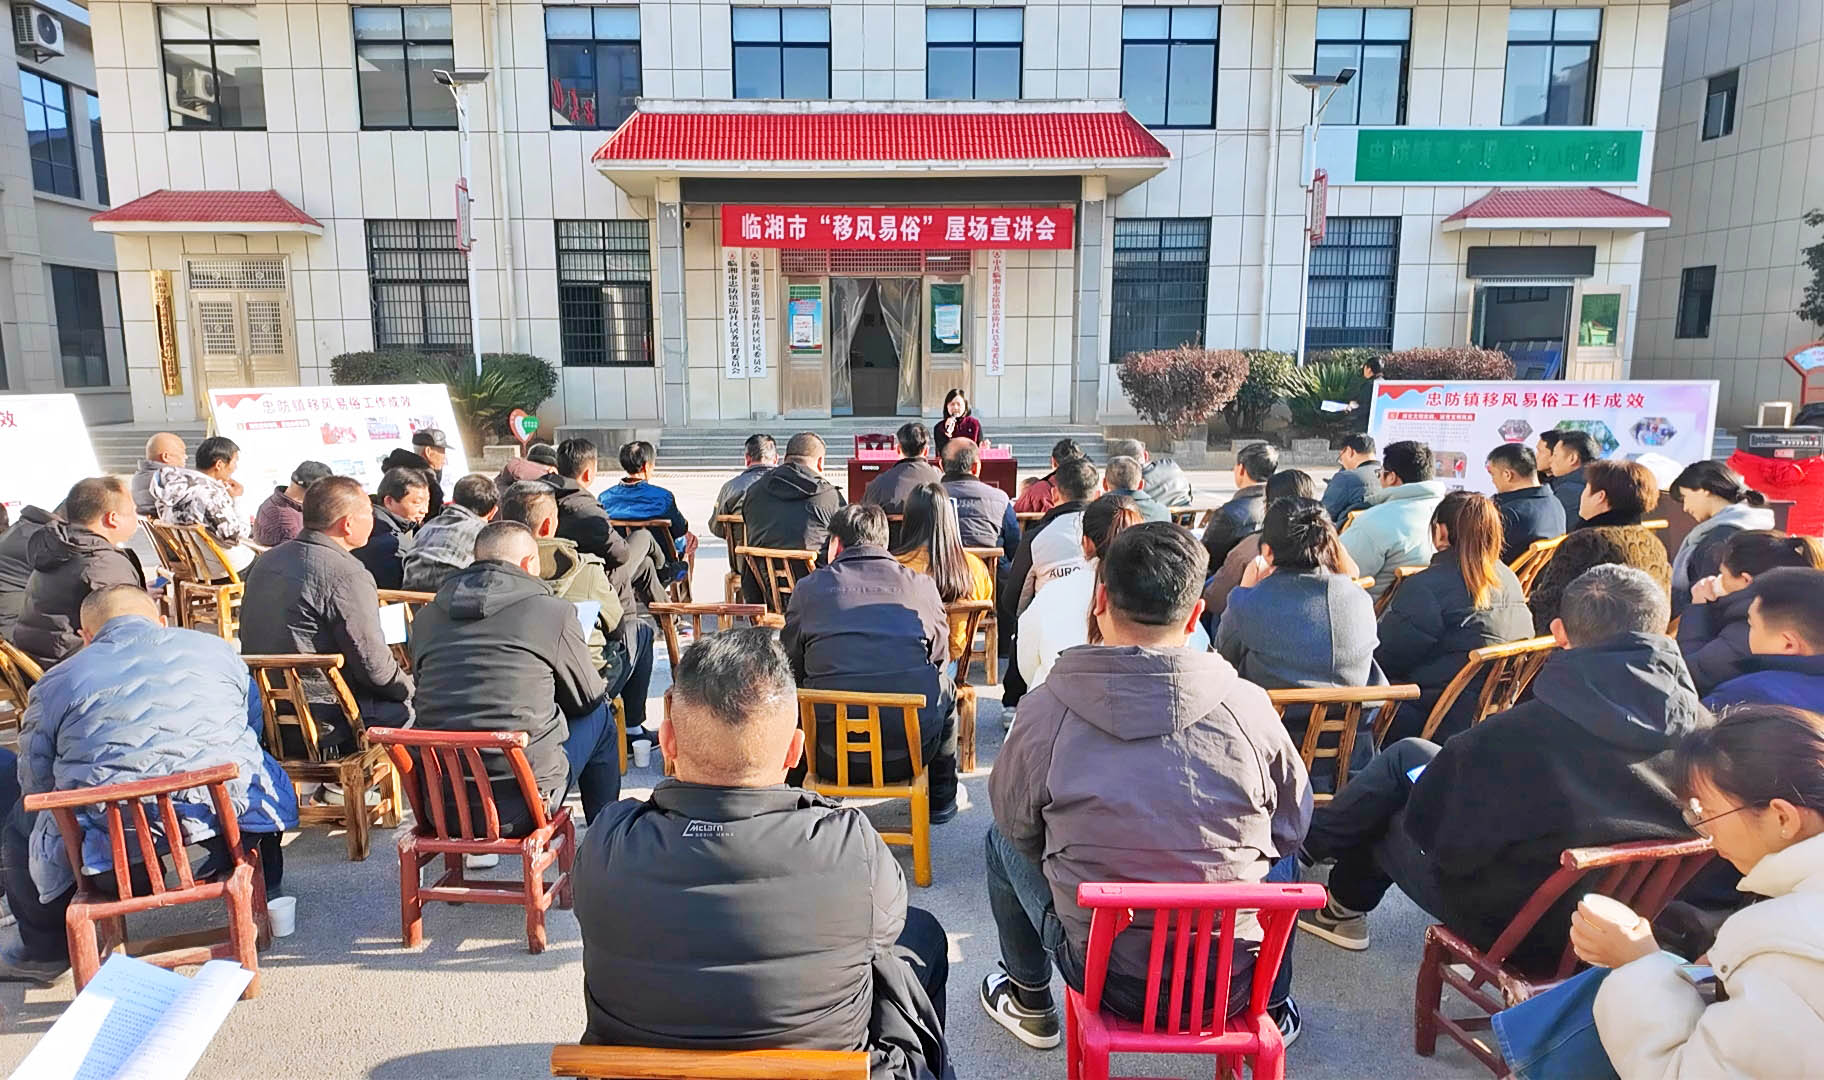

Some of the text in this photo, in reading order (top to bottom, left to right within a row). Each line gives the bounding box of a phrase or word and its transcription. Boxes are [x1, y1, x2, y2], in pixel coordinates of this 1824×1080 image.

[741, 213, 1057, 242] 临湘市“移风易俗”屋场宣讲会
[261, 394, 412, 415] 忠防镇移风易俗工作成效
[1425, 391, 1647, 410] 忠防镇移风易俗工作成效
